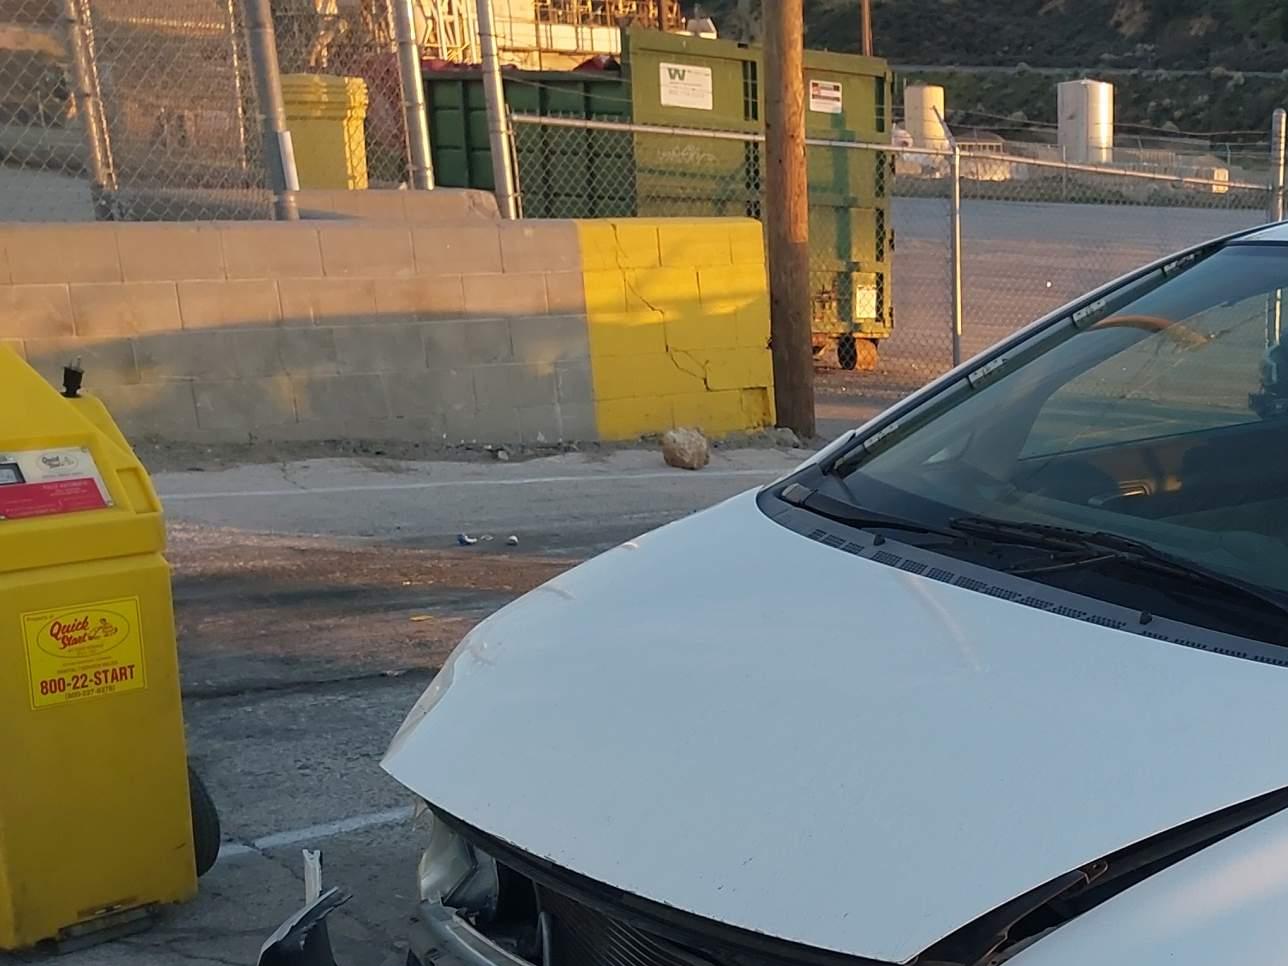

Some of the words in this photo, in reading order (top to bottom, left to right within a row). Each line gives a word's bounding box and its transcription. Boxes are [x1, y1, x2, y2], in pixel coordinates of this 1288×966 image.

[49, 615, 90, 641] Quick
[58, 633, 88, 650] Start
[40, 664, 136, 696] 800-22-START
